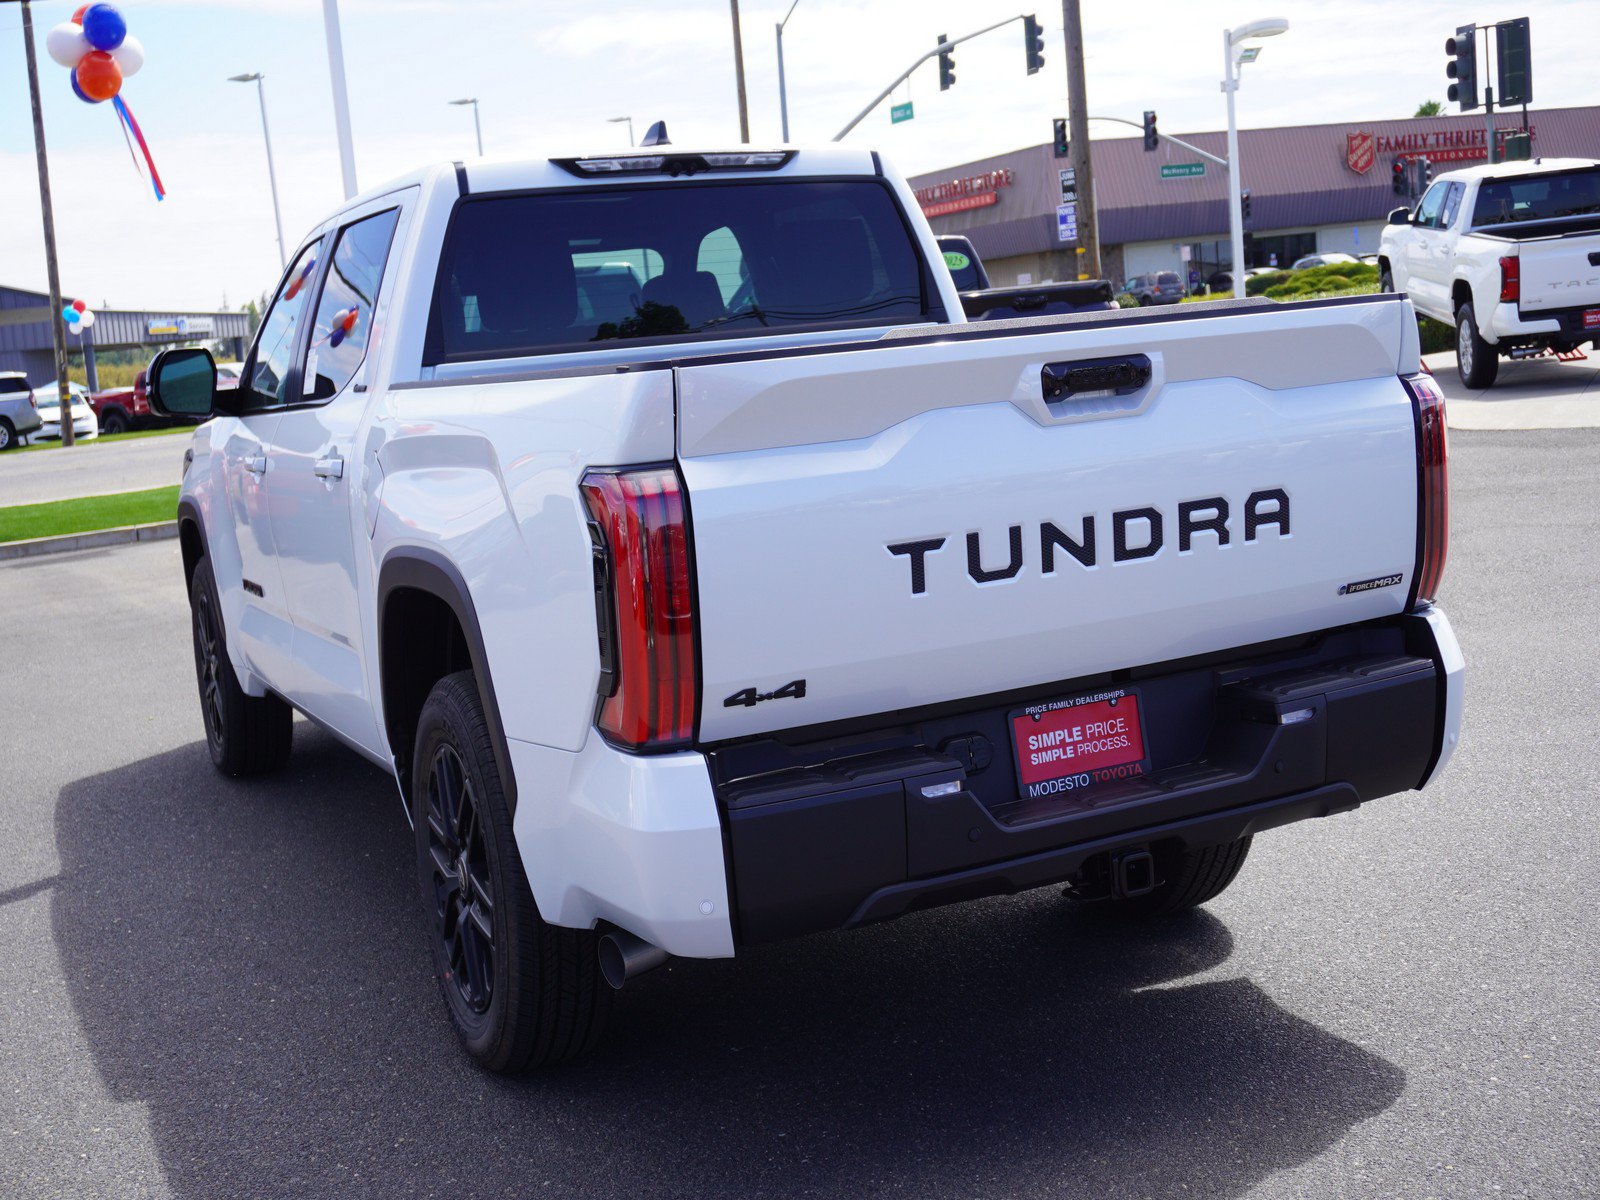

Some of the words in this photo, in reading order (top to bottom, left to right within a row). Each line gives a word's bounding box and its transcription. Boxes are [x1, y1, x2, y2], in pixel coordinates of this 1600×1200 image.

[1377, 132, 1429, 152] FAMILY
[1433, 129, 1488, 148] THRIFT
[1405, 151, 1463, 161] DOATION
[886, 488, 1291, 597] TUNDRA
[1025, 702, 1047, 714] PRICE
[1049, 699, 1074, 711] FAMILY
[1076, 689, 1125, 706] DEALERSHIPS
[1028, 726, 1083, 751] SIMPLE
[1086, 718, 1129, 738] PRICE.
[1030, 746, 1075, 765] SIMPLE
[1077, 735, 1131, 756] PROCESS.
[1029, 773, 1090, 798] MODESTO
[1092, 763, 1143, 783] TOYOTA
